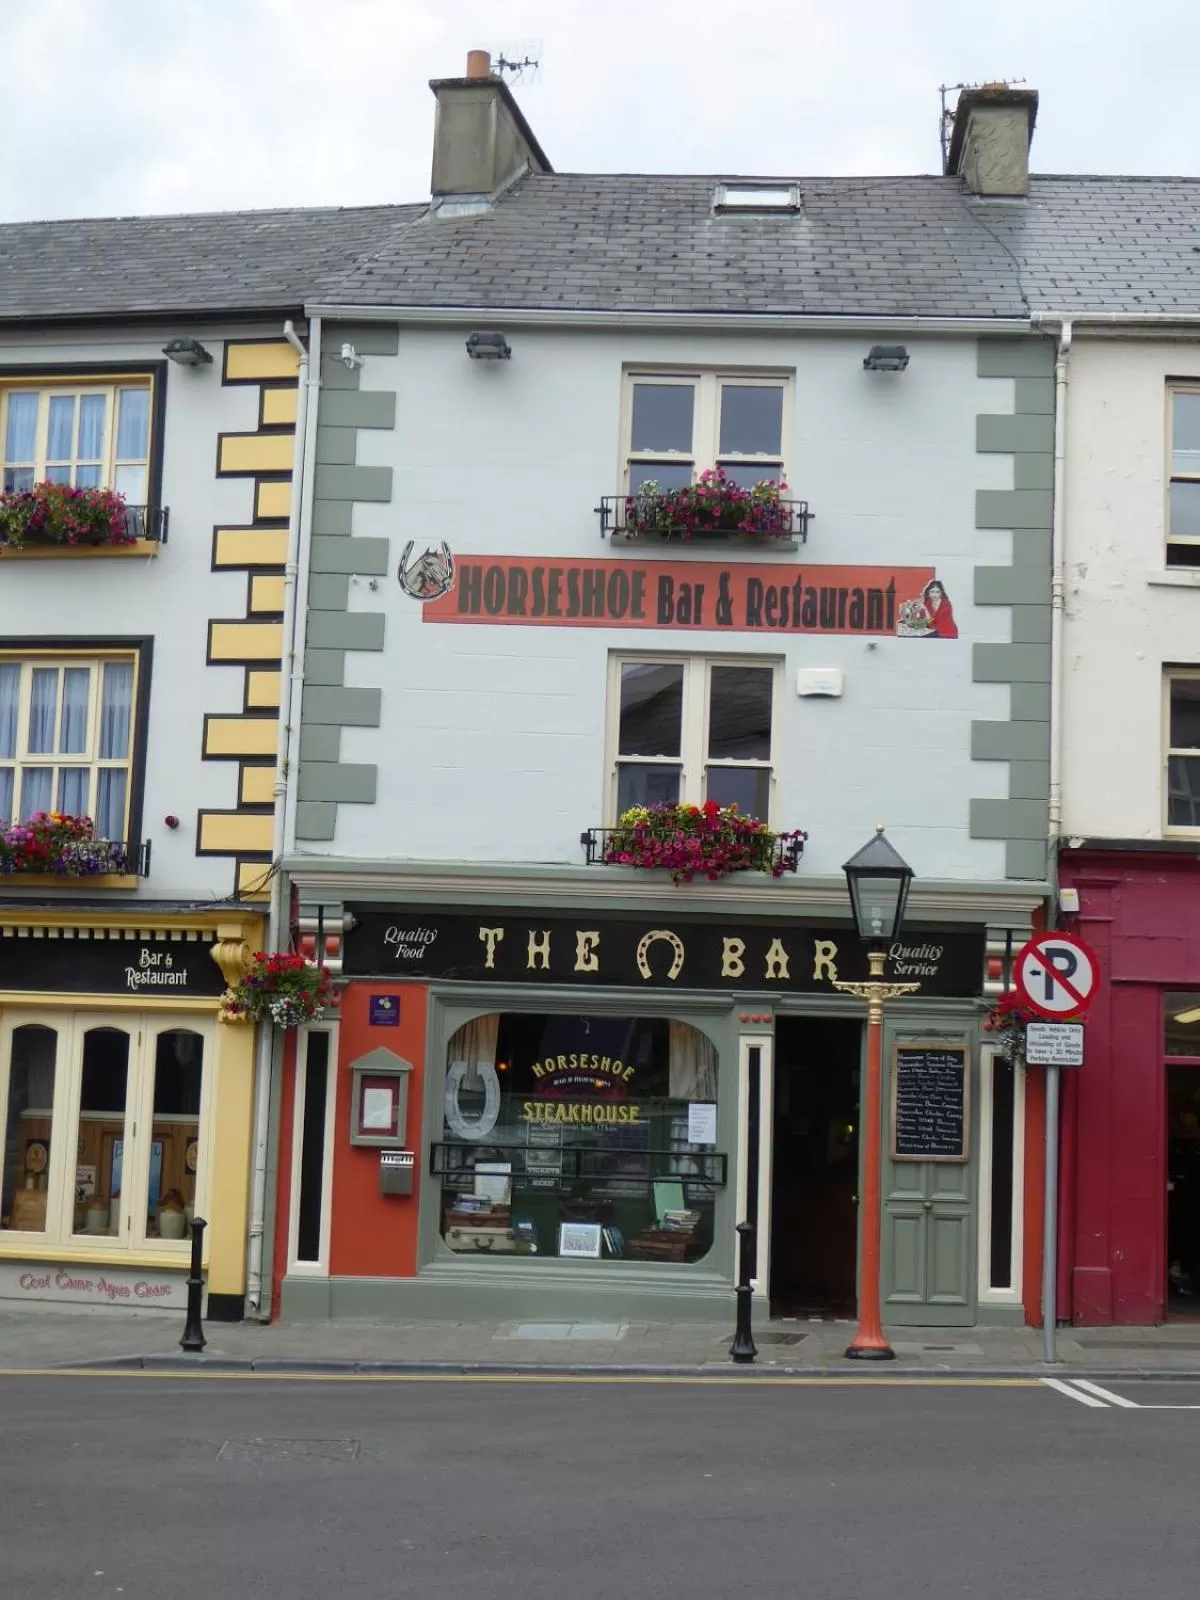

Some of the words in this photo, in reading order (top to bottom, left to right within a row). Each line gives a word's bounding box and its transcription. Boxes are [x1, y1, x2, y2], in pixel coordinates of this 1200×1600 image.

[458, 565, 646, 619] HORSESHOE
[657, 575, 704, 625] Bar
[716, 571, 733, 626] &
[747, 574, 897, 630] Restaurant
[384, 926, 438, 944] Quality
[140, 948, 163, 968] Bar
[165, 953, 173, 967] &
[395, 944, 426, 959] Food
[478, 927, 600, 972] THE
[721, 936, 838, 981] BAR
[888, 943, 944, 960] Quality
[125, 966, 187, 990] Restaurant
[894, 960, 938, 976] Service
[532, 1053, 635, 1082] HORSESHOE
[523, 1102, 640, 1125] STEAKHOUSE
